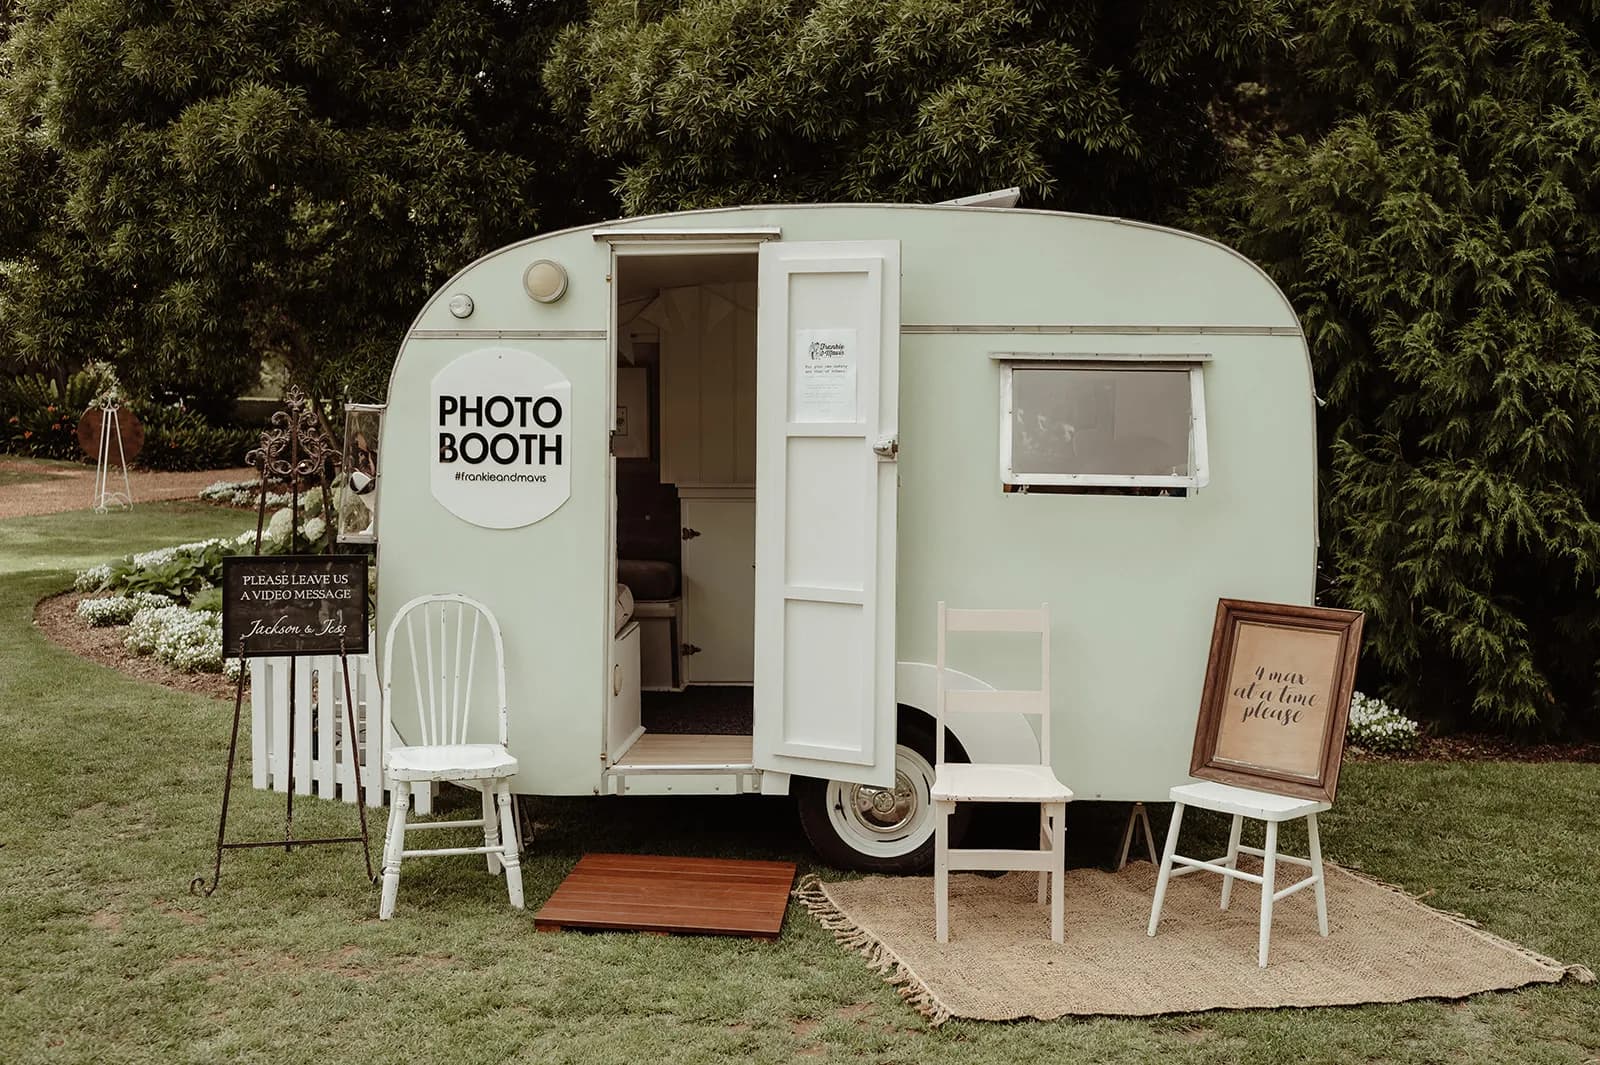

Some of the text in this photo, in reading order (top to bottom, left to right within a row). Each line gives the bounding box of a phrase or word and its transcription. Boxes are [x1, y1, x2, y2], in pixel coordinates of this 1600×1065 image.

[439, 395, 563, 428] PHOTO
[439, 432, 563, 465] BOOTH
[454, 472, 547, 483] #frankieandmavis
[242, 574, 349, 586] PLEASE LEAVE US
[240, 589, 352, 601] A VIDEO MESSAGE
[242, 615, 348, 638] Jackson & Jess
[1255, 665, 1307, 686] 4 max
[1233, 681, 1319, 707] at a time
[1241, 701, 1304, 726] please
